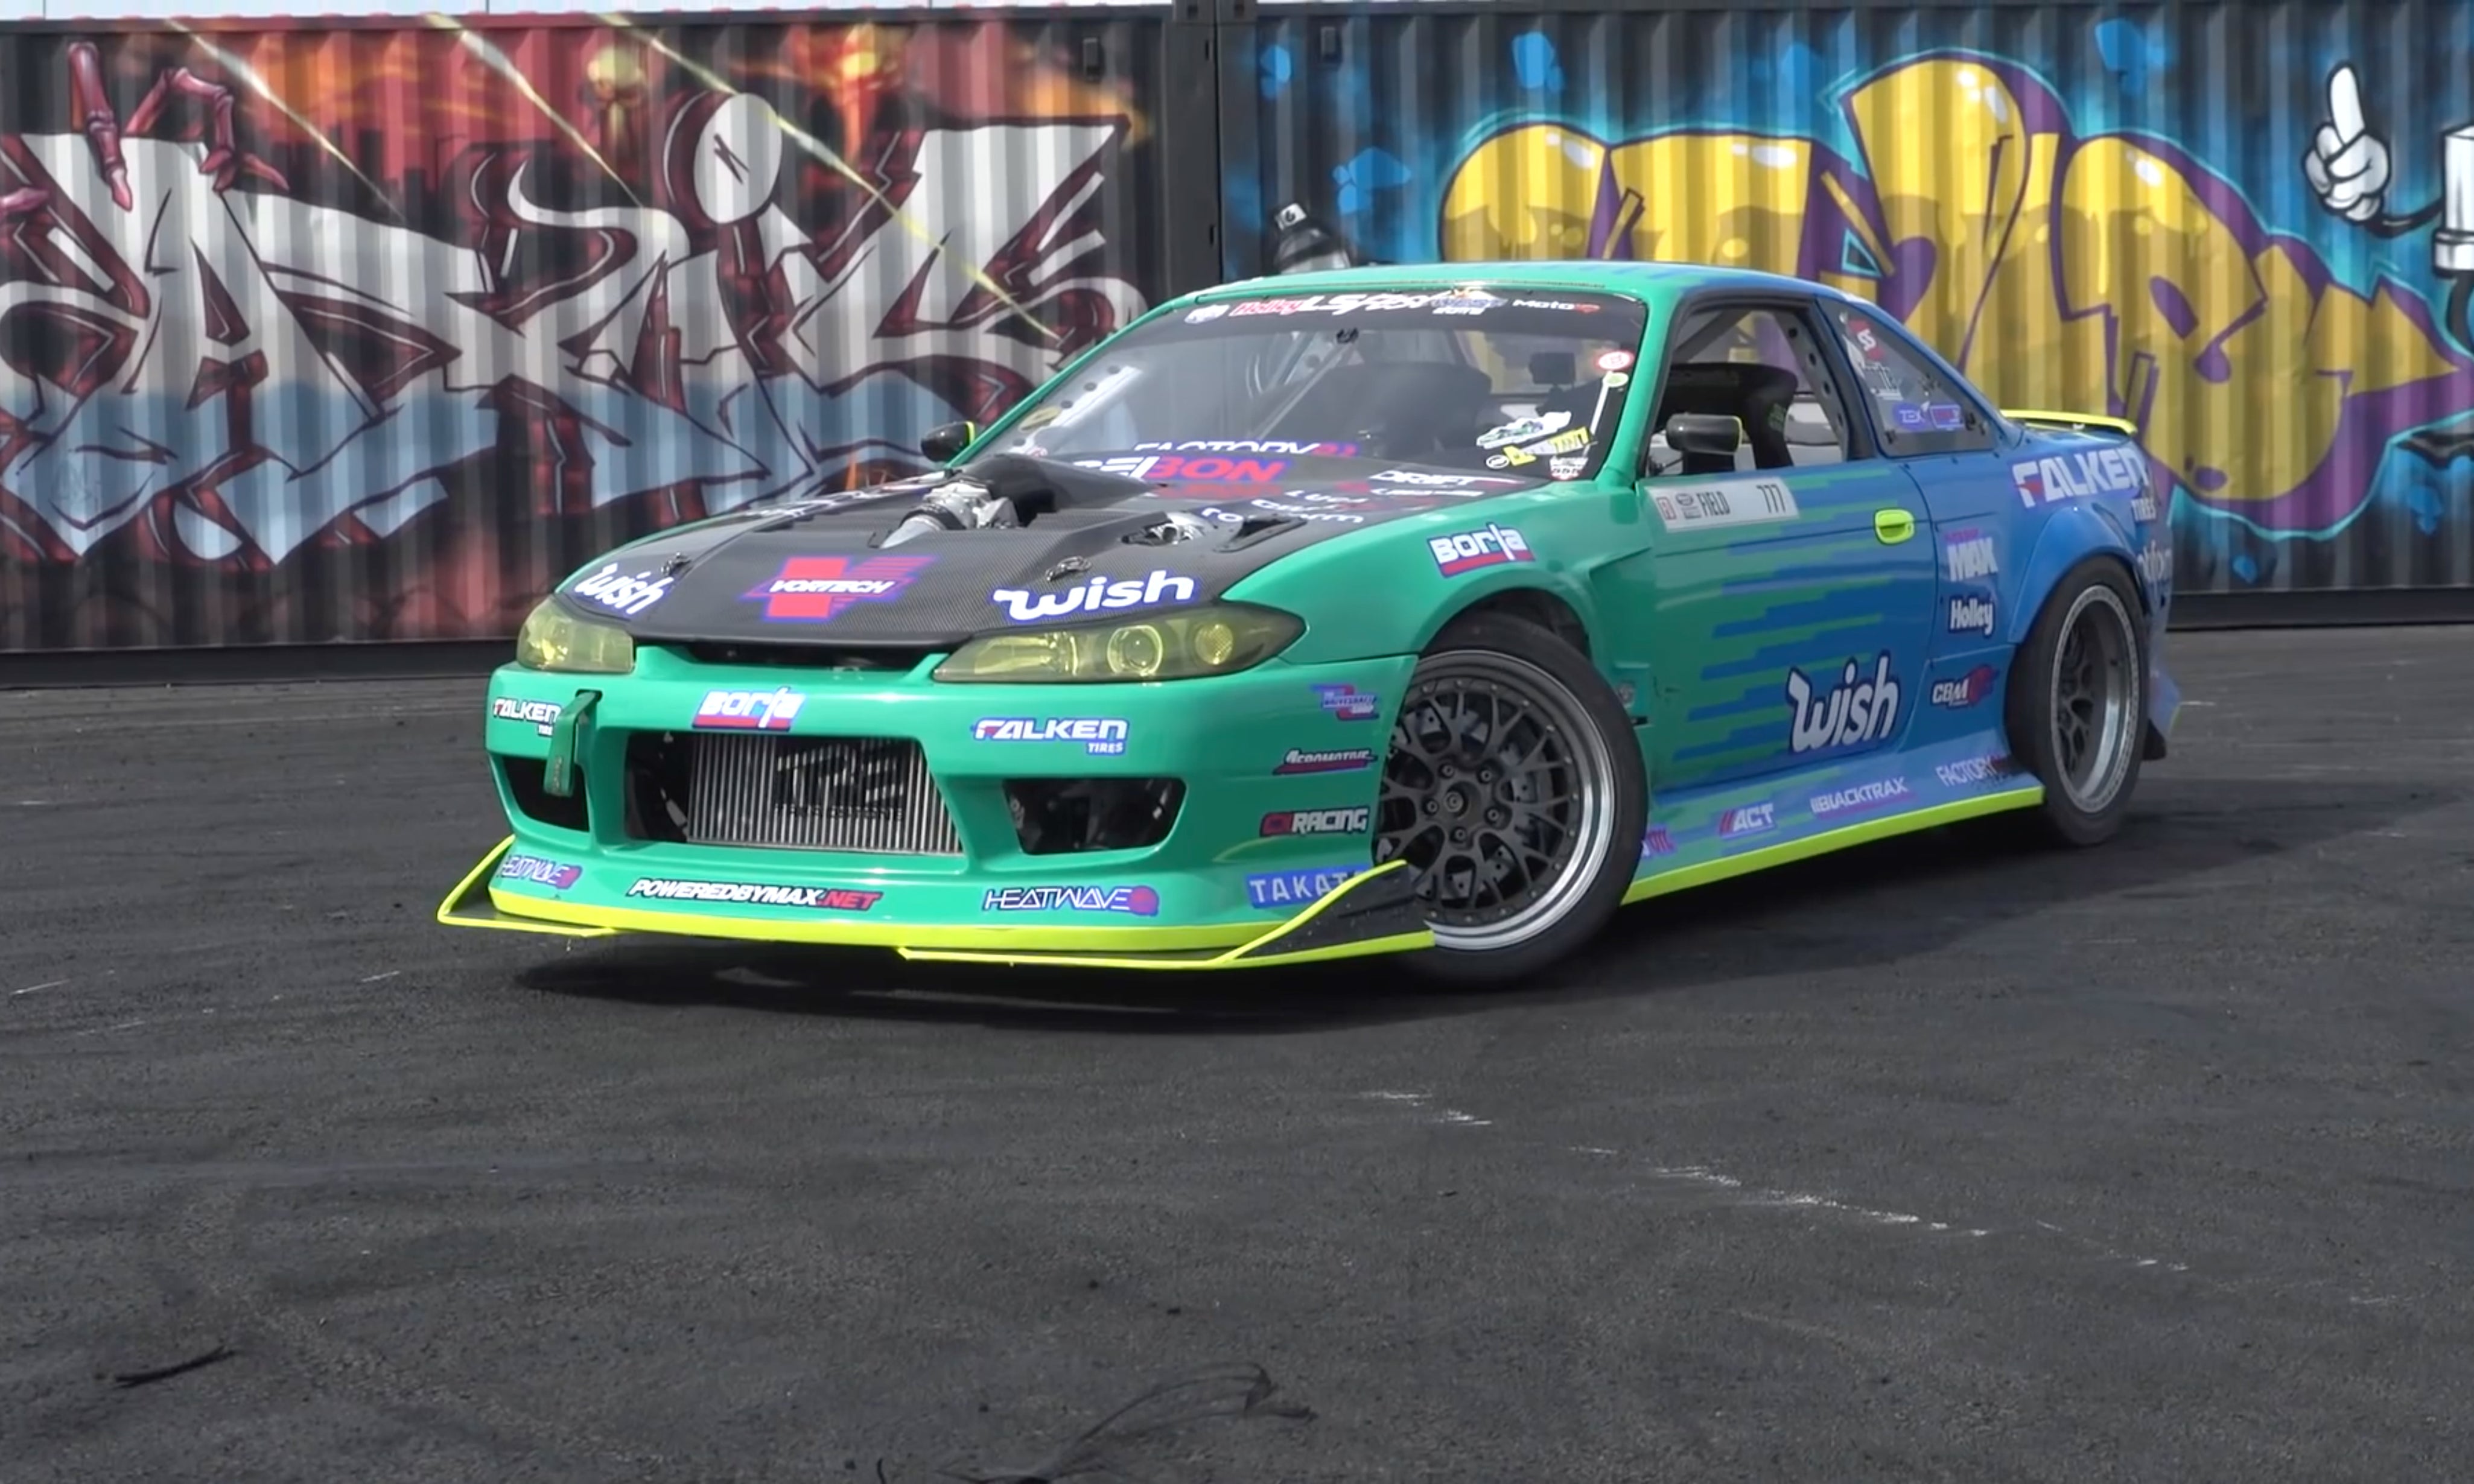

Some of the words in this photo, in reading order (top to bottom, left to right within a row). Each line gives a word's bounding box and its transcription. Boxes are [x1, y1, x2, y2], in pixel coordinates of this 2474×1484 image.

[2012, 448, 2149, 508] FALKEN
[1696, 491, 1731, 517] FIELD
[1756, 484, 1786, 513] 777
[575, 563, 673, 615] wish
[768, 578, 895, 595] VORTECH
[993, 570, 1195, 621] wish
[1950, 597, 1993, 635] Holley
[1788, 656, 1899, 753] wish
[975, 720, 1127, 740] FALKEN
[1088, 742, 1123, 753] TIRES
[1292, 808, 1369, 834] RACING
[1734, 803, 1773, 831] ACT
[629, 881, 879, 910] POWEREDBYMAX.NET
[984, 889, 1133, 910] HEATWAVE
[1250, 873, 1360, 904] TAKAT
